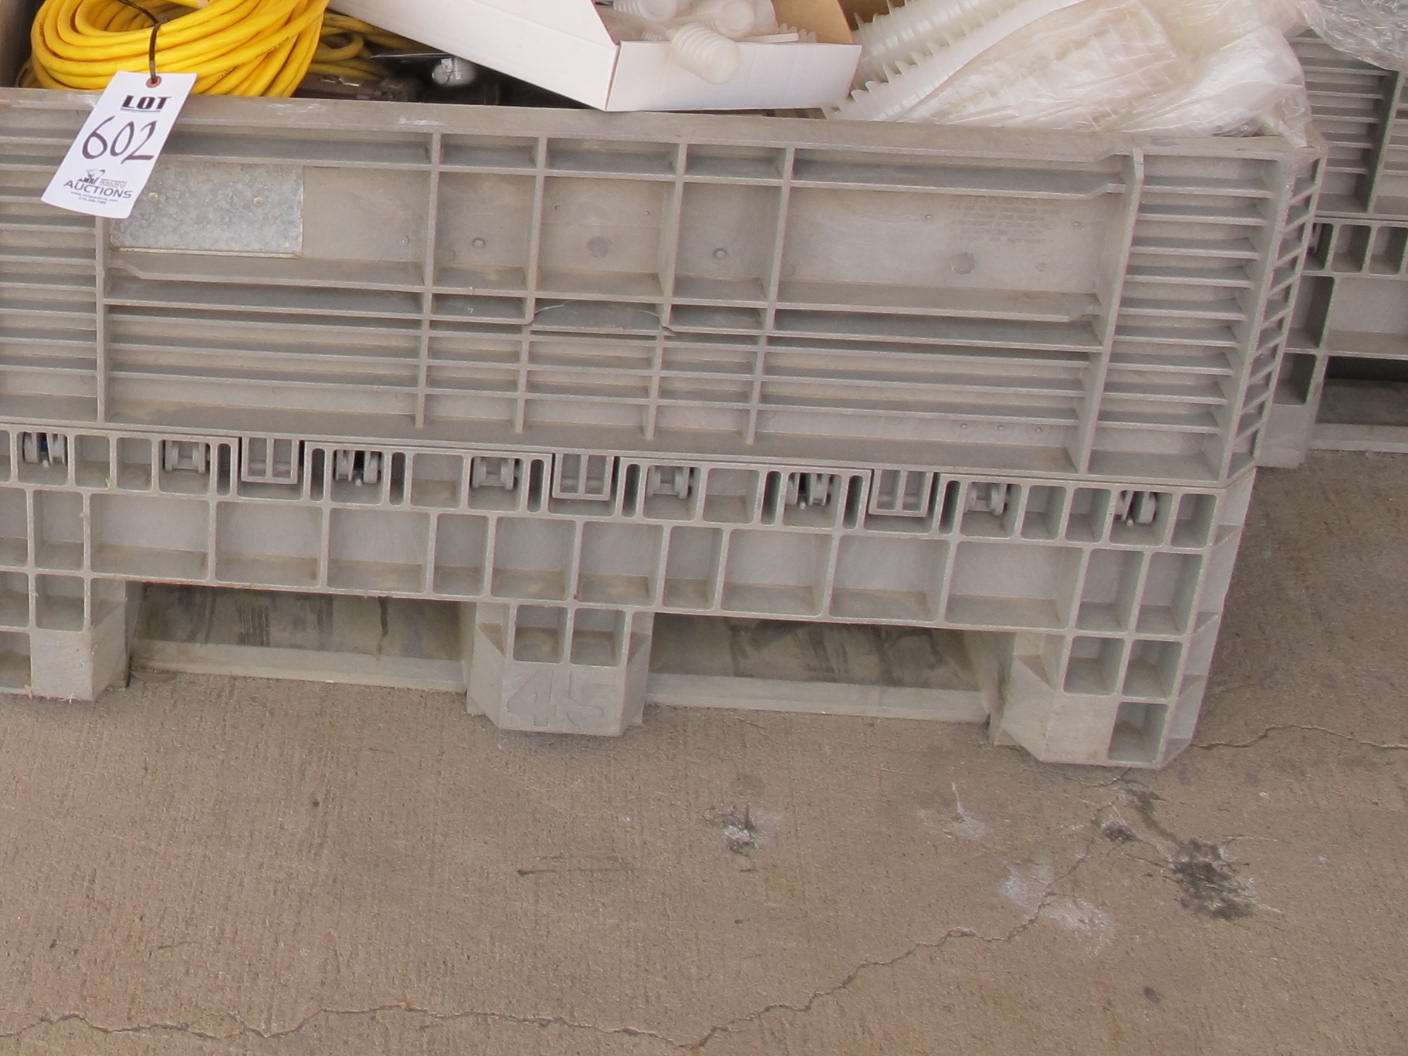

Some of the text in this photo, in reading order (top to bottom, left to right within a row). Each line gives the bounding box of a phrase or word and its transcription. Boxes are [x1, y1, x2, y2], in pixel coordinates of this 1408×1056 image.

[122, 94, 172, 110] LOT
[82, 115, 157, 165] 602
[64, 180, 133, 199] AUCTIONS
